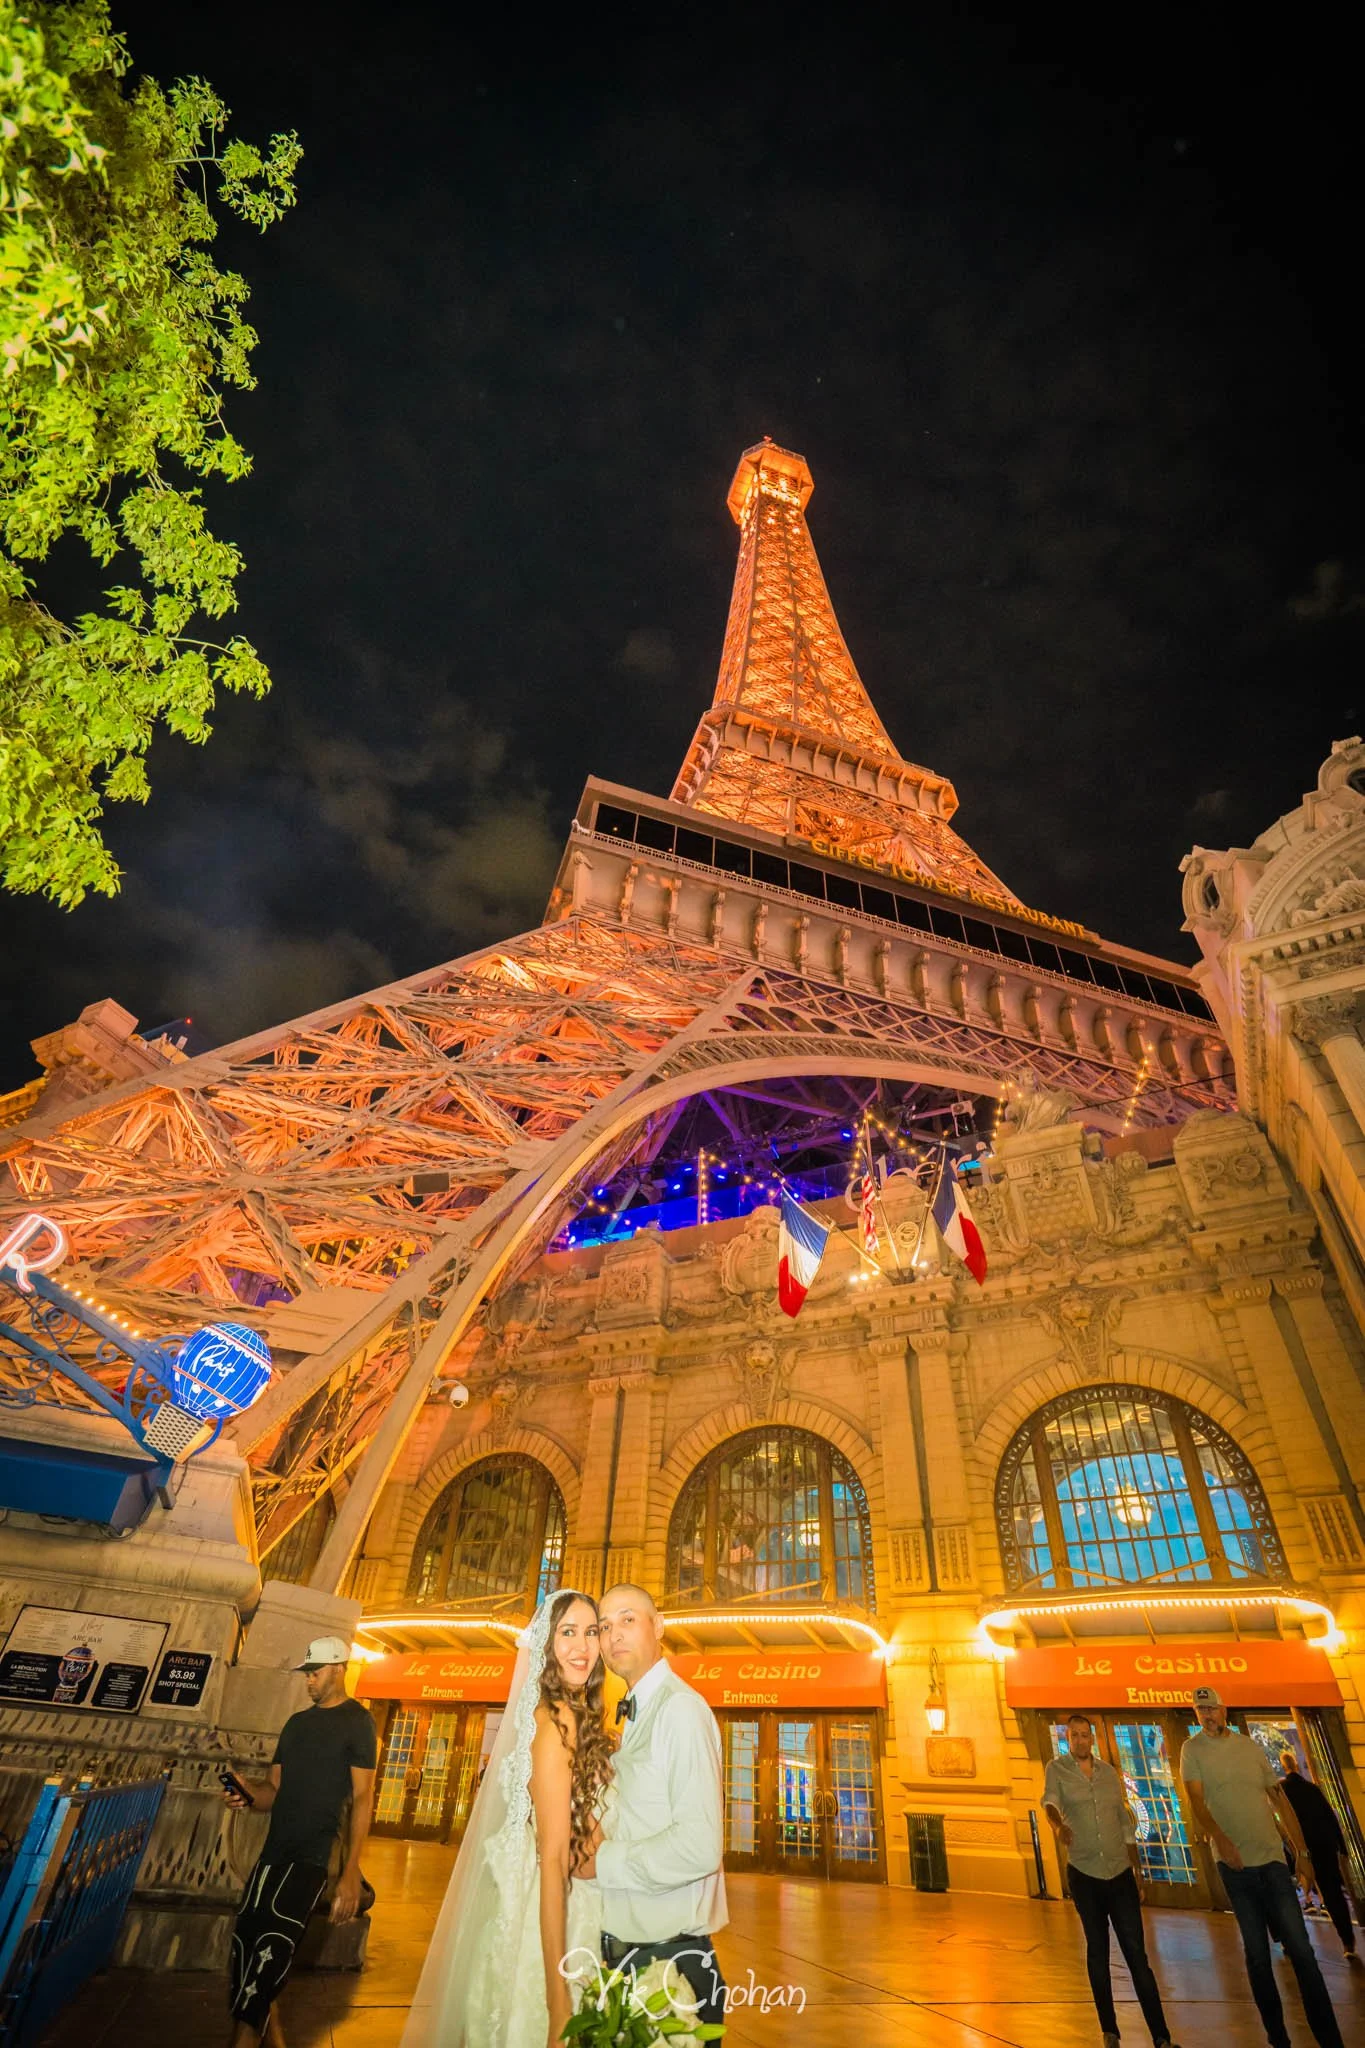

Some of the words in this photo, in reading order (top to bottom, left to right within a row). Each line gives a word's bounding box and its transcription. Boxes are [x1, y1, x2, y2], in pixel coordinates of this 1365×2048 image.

[811, 838, 884, 871] EIFFEL
[889, 862, 961, 896] TOWER
[969, 886, 1085, 938] RESTAURANT
[192, 1344, 235, 1377] Paris
[168, 1656, 187, 1665] ARC
[187, 1658, 205, 1667] BAR
[403, 1661, 430, 1676] Le
[440, 1661, 504, 1678] Casino
[1074, 1657, 1112, 1675] Le
[1135, 1653, 1248, 1674] Casino
[169, 1669, 196, 1680] $3.99
[692, 1663, 722, 1680] Le
[738, 1661, 821, 1680] Casino
[158, 1680, 176, 1688] SHOT
[175, 1681, 200, 1690] SPECIAL
[421, 1685, 464, 1699] Entrance
[722, 1689, 779, 1704] Entrance
[1126, 1687, 1194, 1704] Entranc
